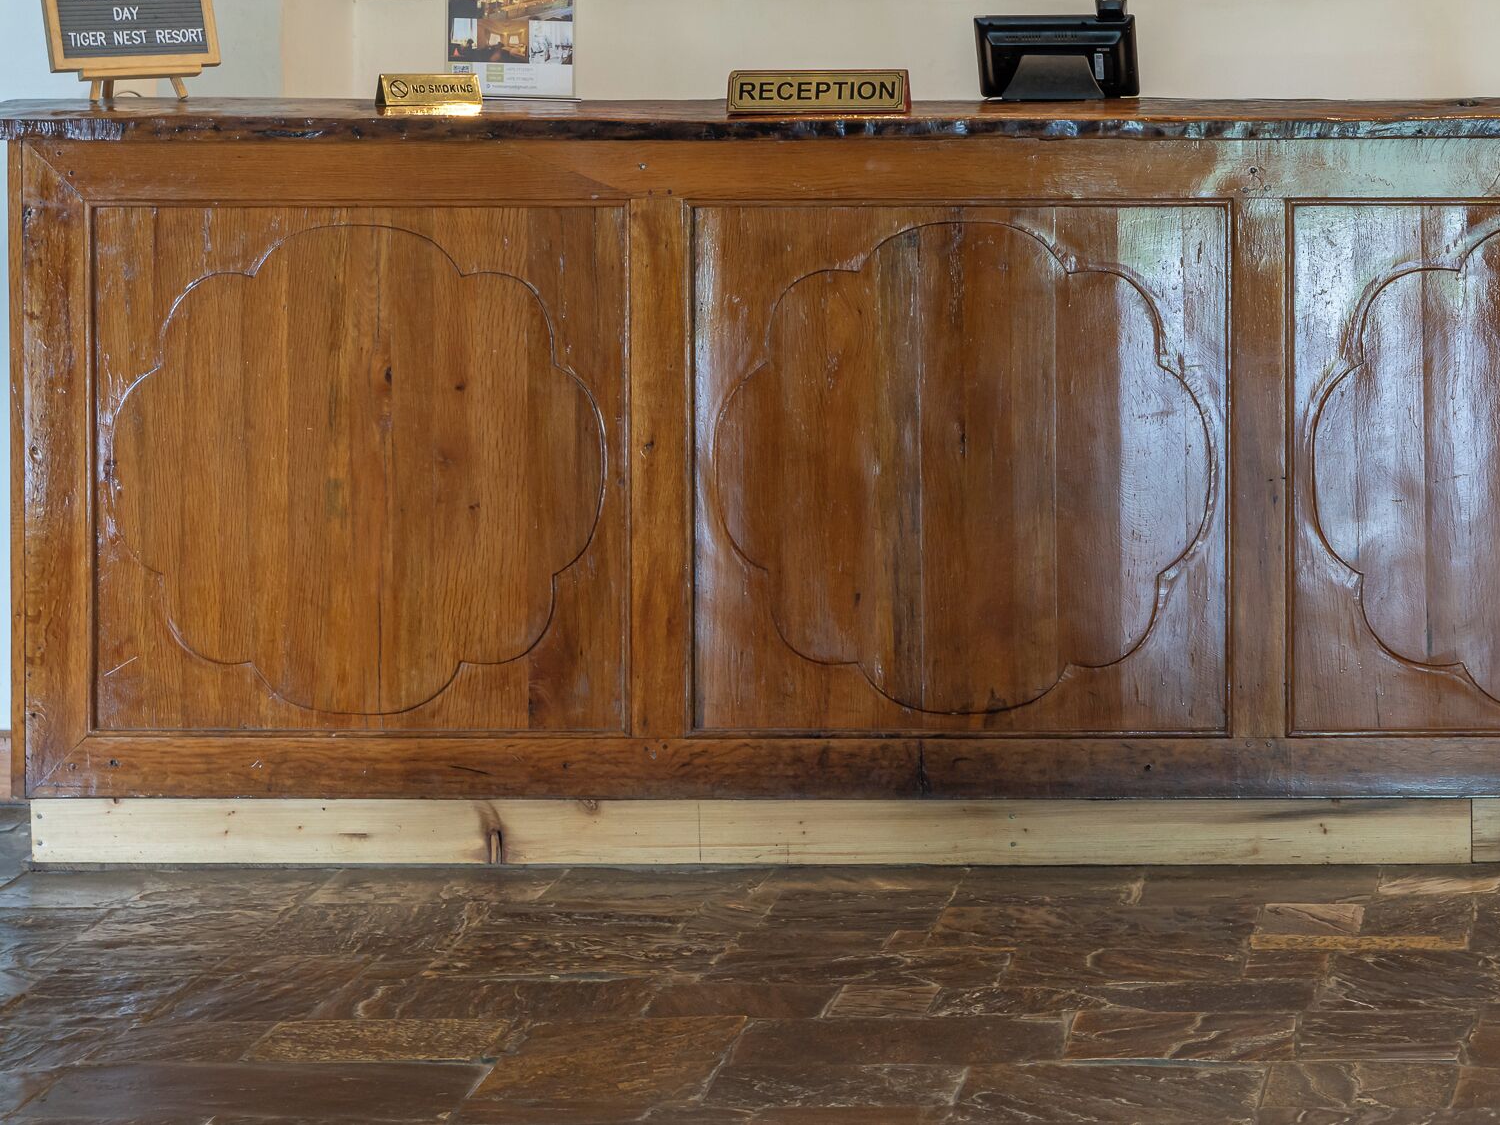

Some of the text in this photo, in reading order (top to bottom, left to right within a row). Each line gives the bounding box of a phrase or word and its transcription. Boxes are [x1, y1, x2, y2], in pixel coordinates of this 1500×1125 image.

[113, 6, 139, 21] DAY
[68, 28, 203, 47] TIGER NEST RESORT
[411, 84, 474, 94] NO SMOKING
[737, 81, 896, 101] RECEPTION
